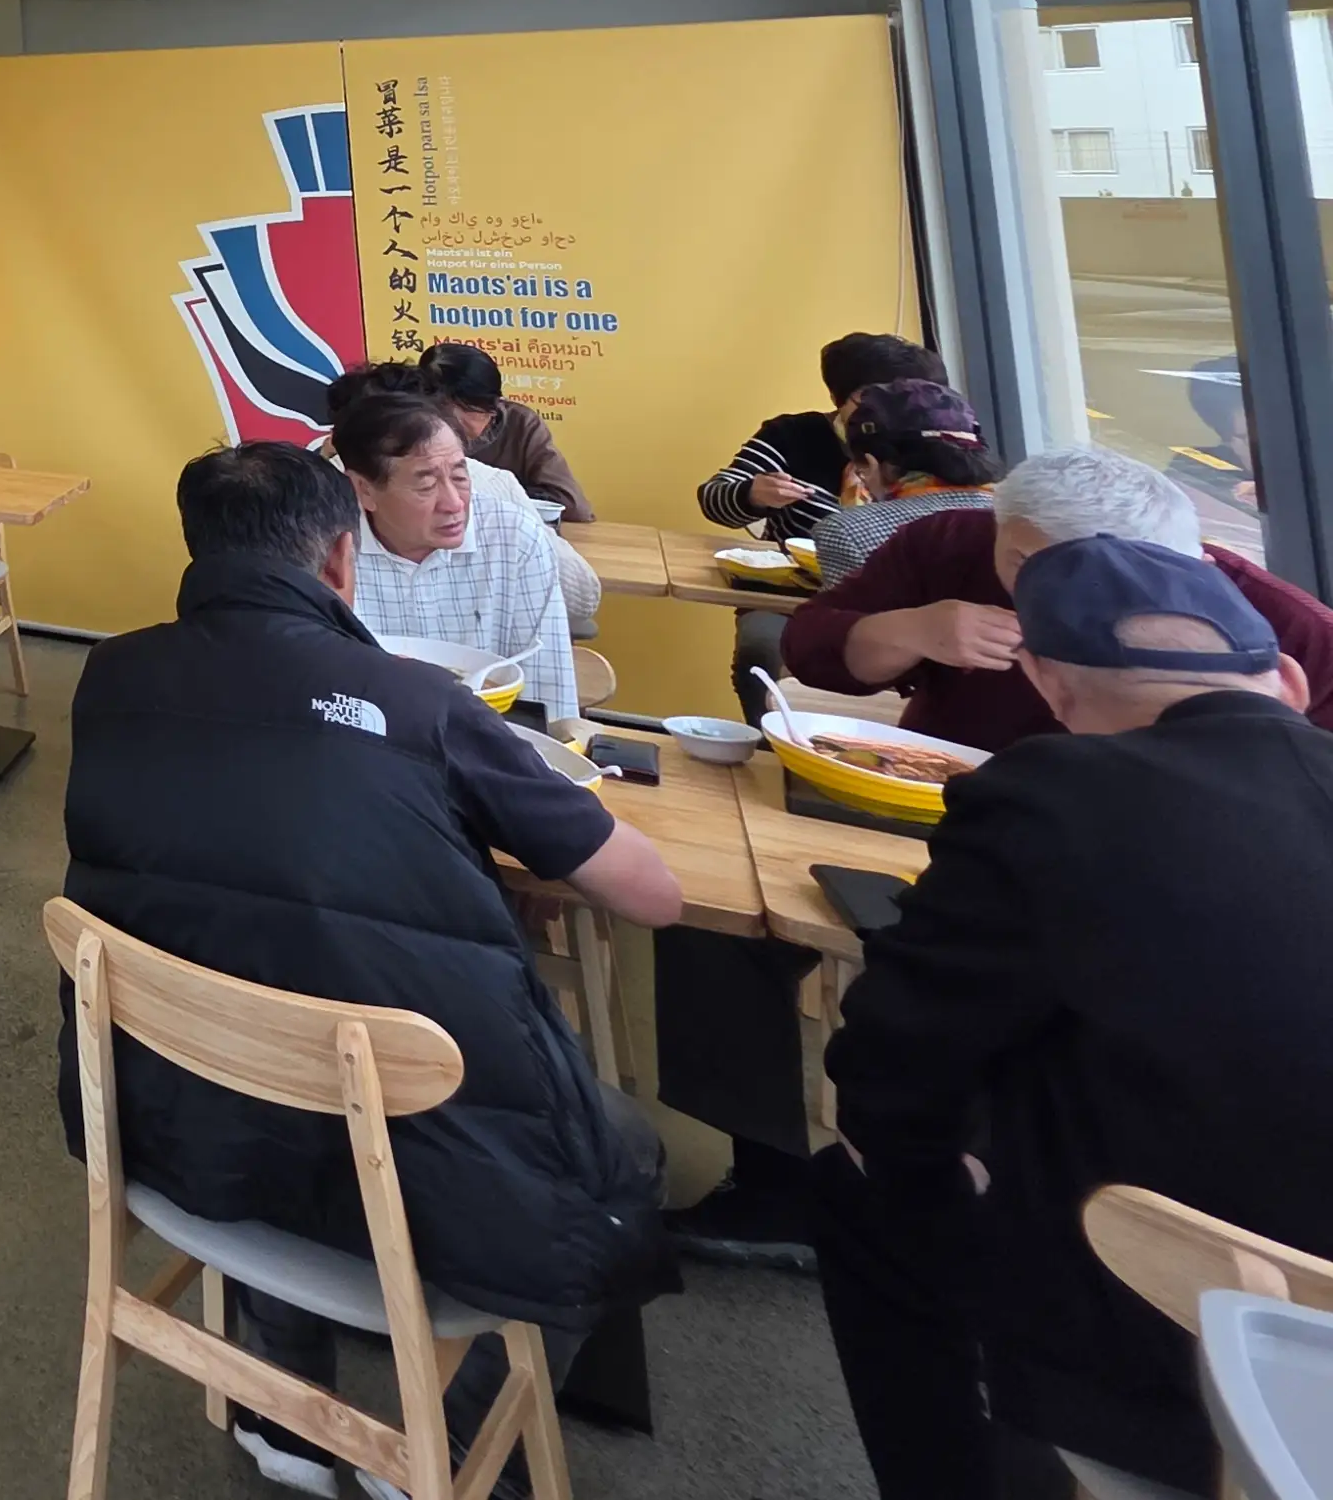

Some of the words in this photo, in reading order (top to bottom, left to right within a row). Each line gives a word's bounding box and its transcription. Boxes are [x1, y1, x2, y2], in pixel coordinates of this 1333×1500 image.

[419, 101, 430, 116] sa
[421, 120, 438, 151] para
[421, 156, 440, 206] Hotpot
[494, 249, 513, 258] ein
[427, 258, 468, 268] Hotpot
[490, 260, 516, 269] eine
[519, 261, 562, 271] Person
[428, 272, 537, 297] Maots'ai
[544, 275, 569, 298] is
[576, 279, 593, 299] a
[430, 303, 515, 328] hotpot
[520, 306, 558, 329] for
[565, 312, 618, 332] one
[311, 698, 362, 720] NORTH
[332, 692, 362, 707] THE
[323, 710, 362, 729] FACE
